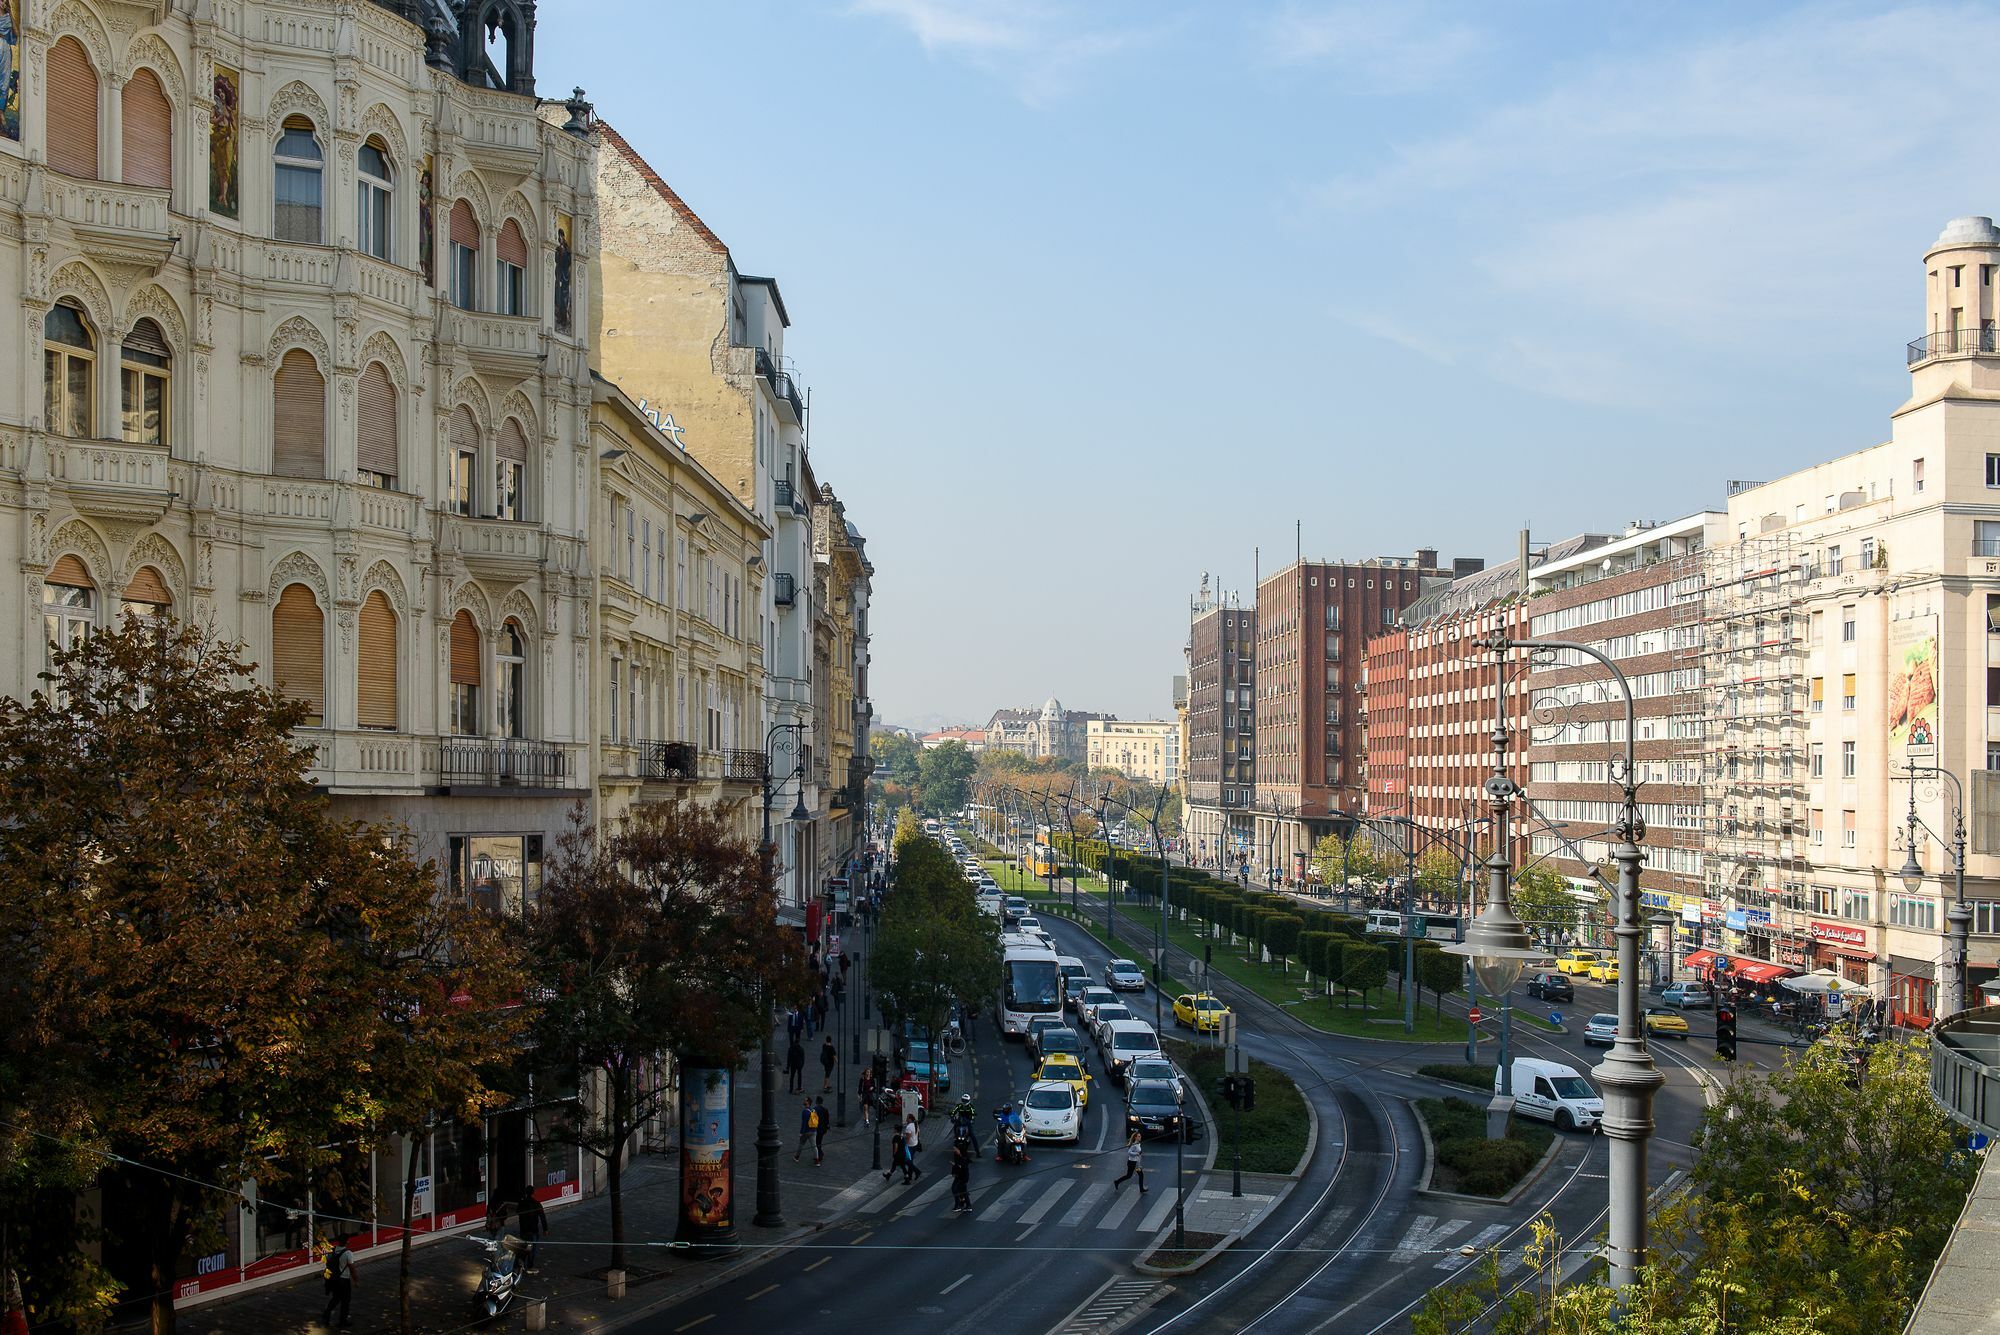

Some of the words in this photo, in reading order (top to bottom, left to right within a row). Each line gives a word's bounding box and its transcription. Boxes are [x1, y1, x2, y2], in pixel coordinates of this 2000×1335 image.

[494, 859, 518, 879] SHOP
[1717, 957, 1725, 967] P
[1830, 995, 1838, 1003] P
[196, 1251, 226, 1275] cream
